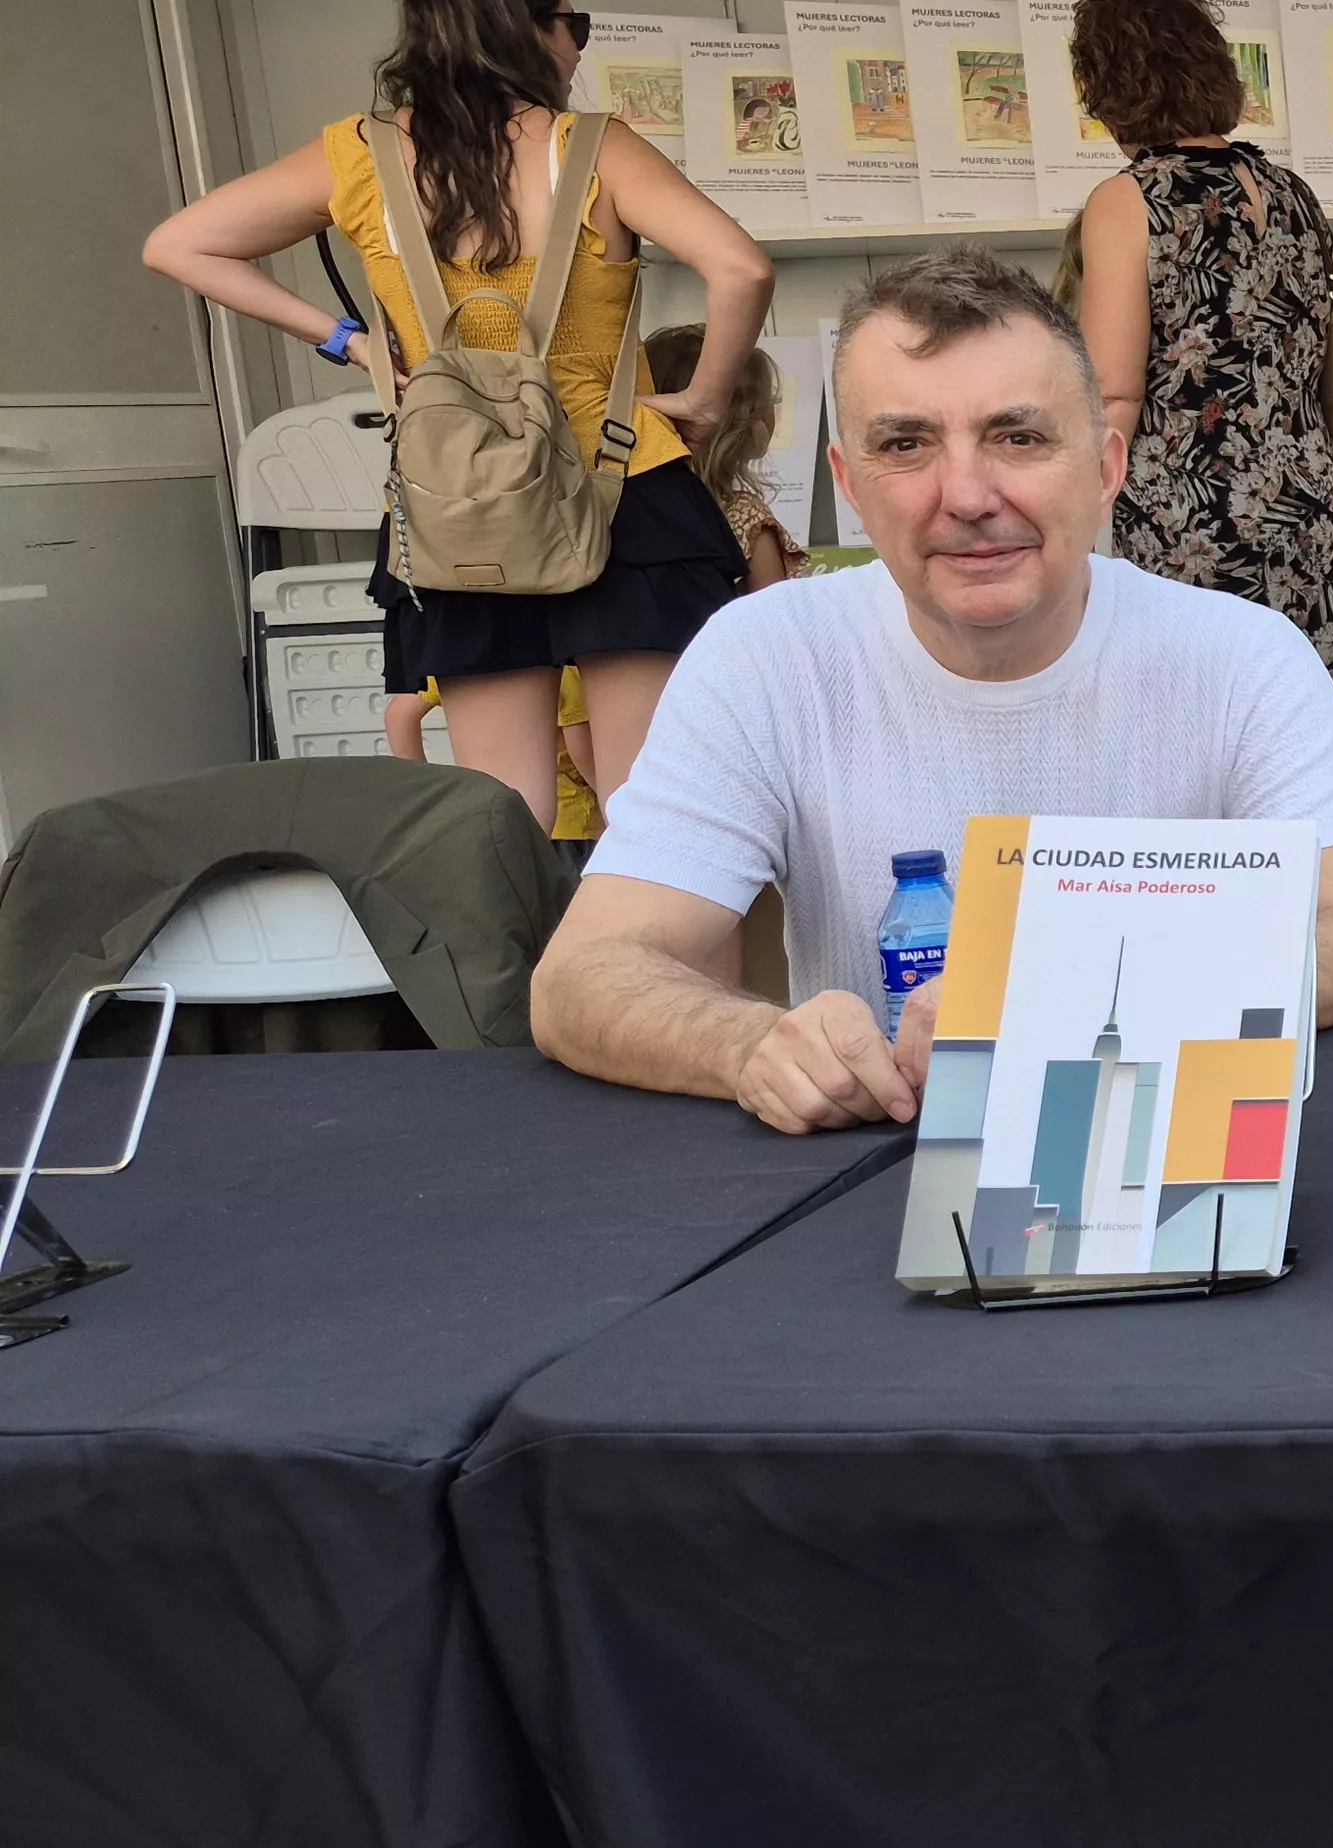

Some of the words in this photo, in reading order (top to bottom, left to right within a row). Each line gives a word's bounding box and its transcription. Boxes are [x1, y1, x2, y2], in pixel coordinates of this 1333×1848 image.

[912, 8, 952, 17] MUJERES
[954, 10, 1000, 19] LECTORAS
[797, 13, 837, 22] MUJERES
[840, 15, 886, 23] LECTORAS
[821, 24, 836, 32] qué
[935, 20, 951, 28] qué
[615, 25, 663, 33] LECTORAS
[1077, 151, 1116, 159] MUJERES
[848, 160, 888, 168] MUJERES
[961, 157, 1001, 165] MUJERES
[996, 848, 1024, 865] LA
[1032, 848, 1126, 869] CIUDAD
[1132, 850, 1282, 870] ESMERILADA
[1057, 878, 1092, 892] Mar
[1096, 878, 1133, 894] Aísa
[1137, 880, 1217, 895] Poderoso
[899, 950, 926, 962] BAJA
[927, 948, 942, 959] EN
